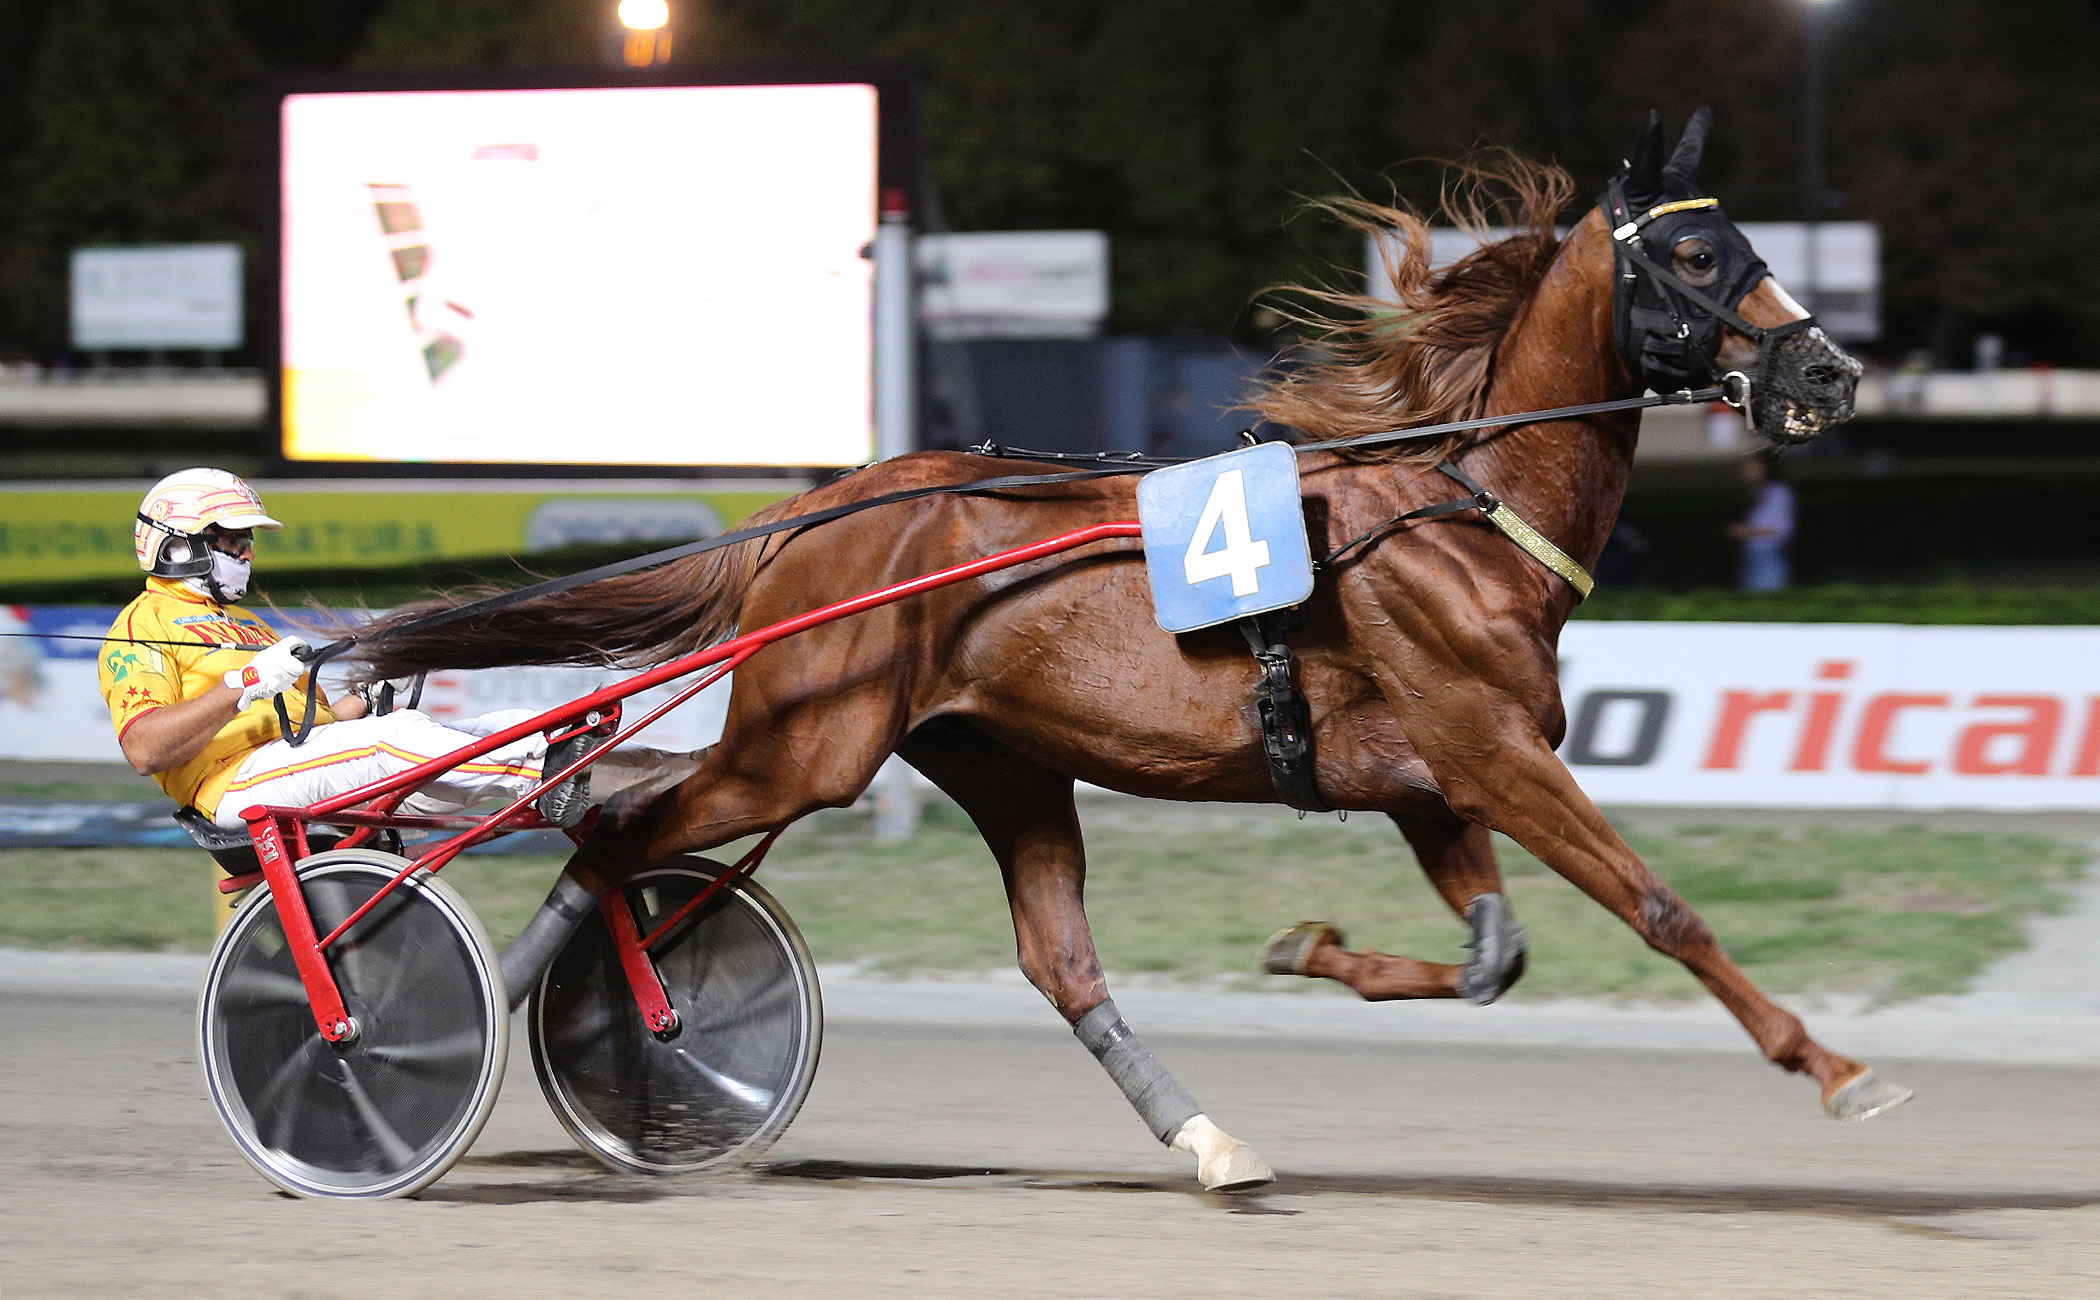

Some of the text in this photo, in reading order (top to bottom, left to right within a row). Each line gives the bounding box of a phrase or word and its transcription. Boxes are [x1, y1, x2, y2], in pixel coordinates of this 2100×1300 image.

[1183, 468, 1271, 598] 4
[243, 667, 258, 683] AG
[1557, 655, 1678, 768] o
